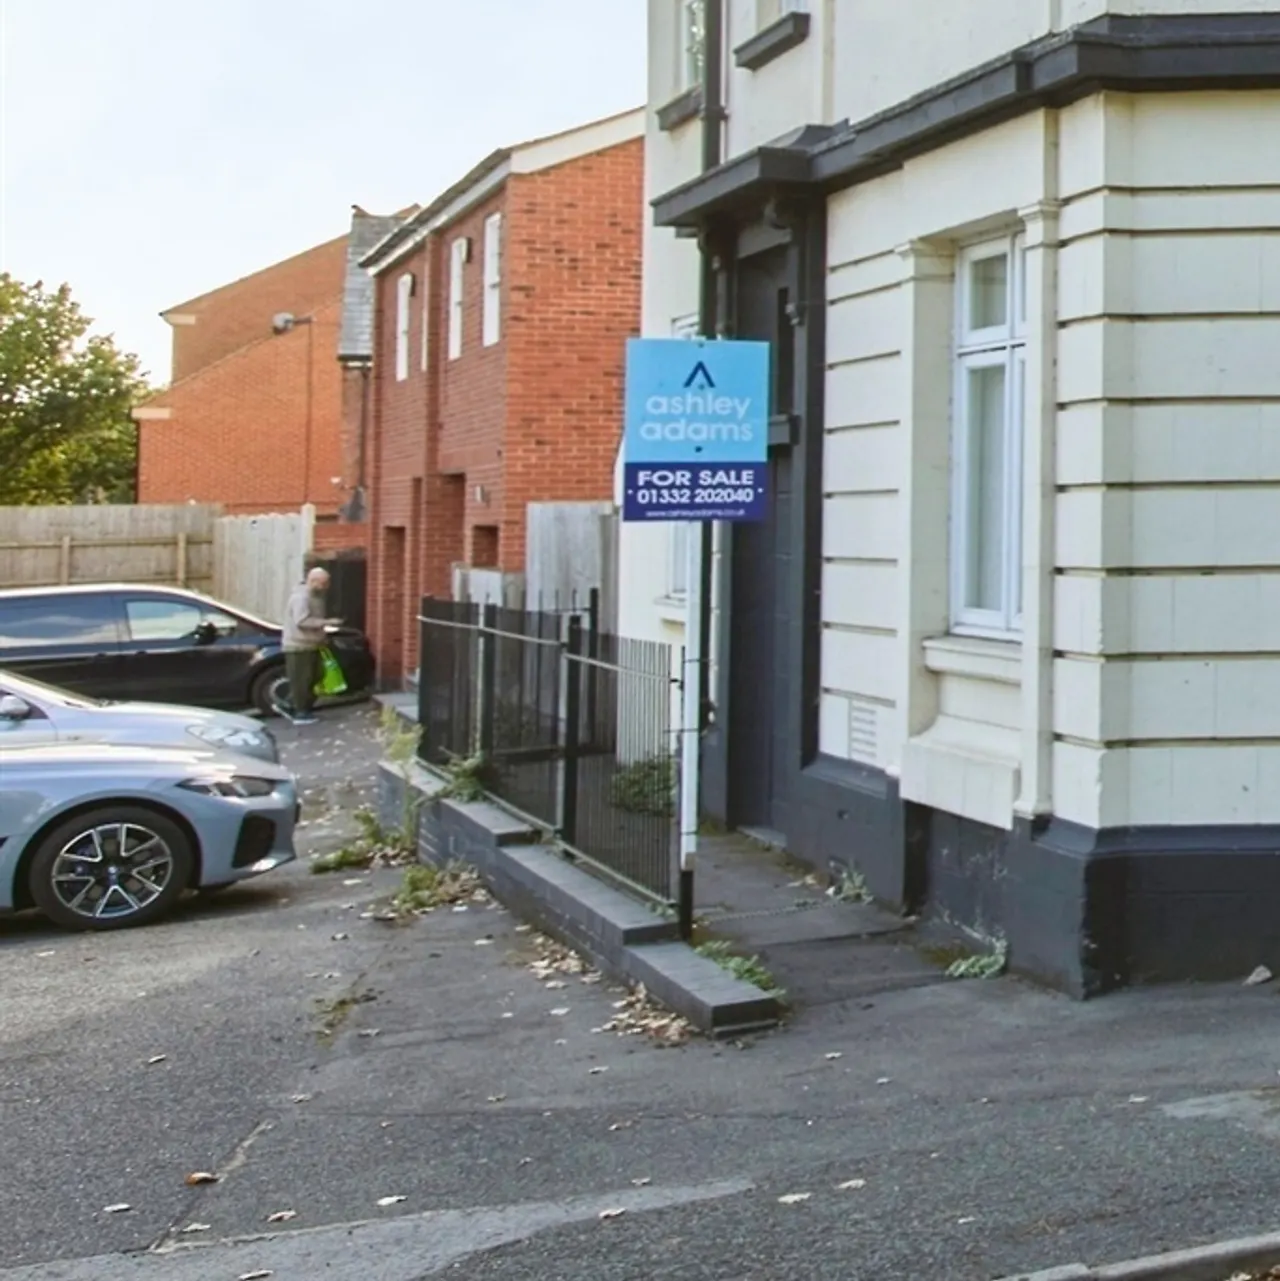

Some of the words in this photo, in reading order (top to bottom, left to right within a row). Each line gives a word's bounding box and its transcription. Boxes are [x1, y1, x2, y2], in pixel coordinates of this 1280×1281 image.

[645, 391, 752, 420] ashley
[639, 418, 754, 442] adams
[637, 470, 692, 486] FOR
[698, 469, 755, 486] SALE
[636, 488, 691, 504] 01332
[694, 487, 755, 503] 202040
